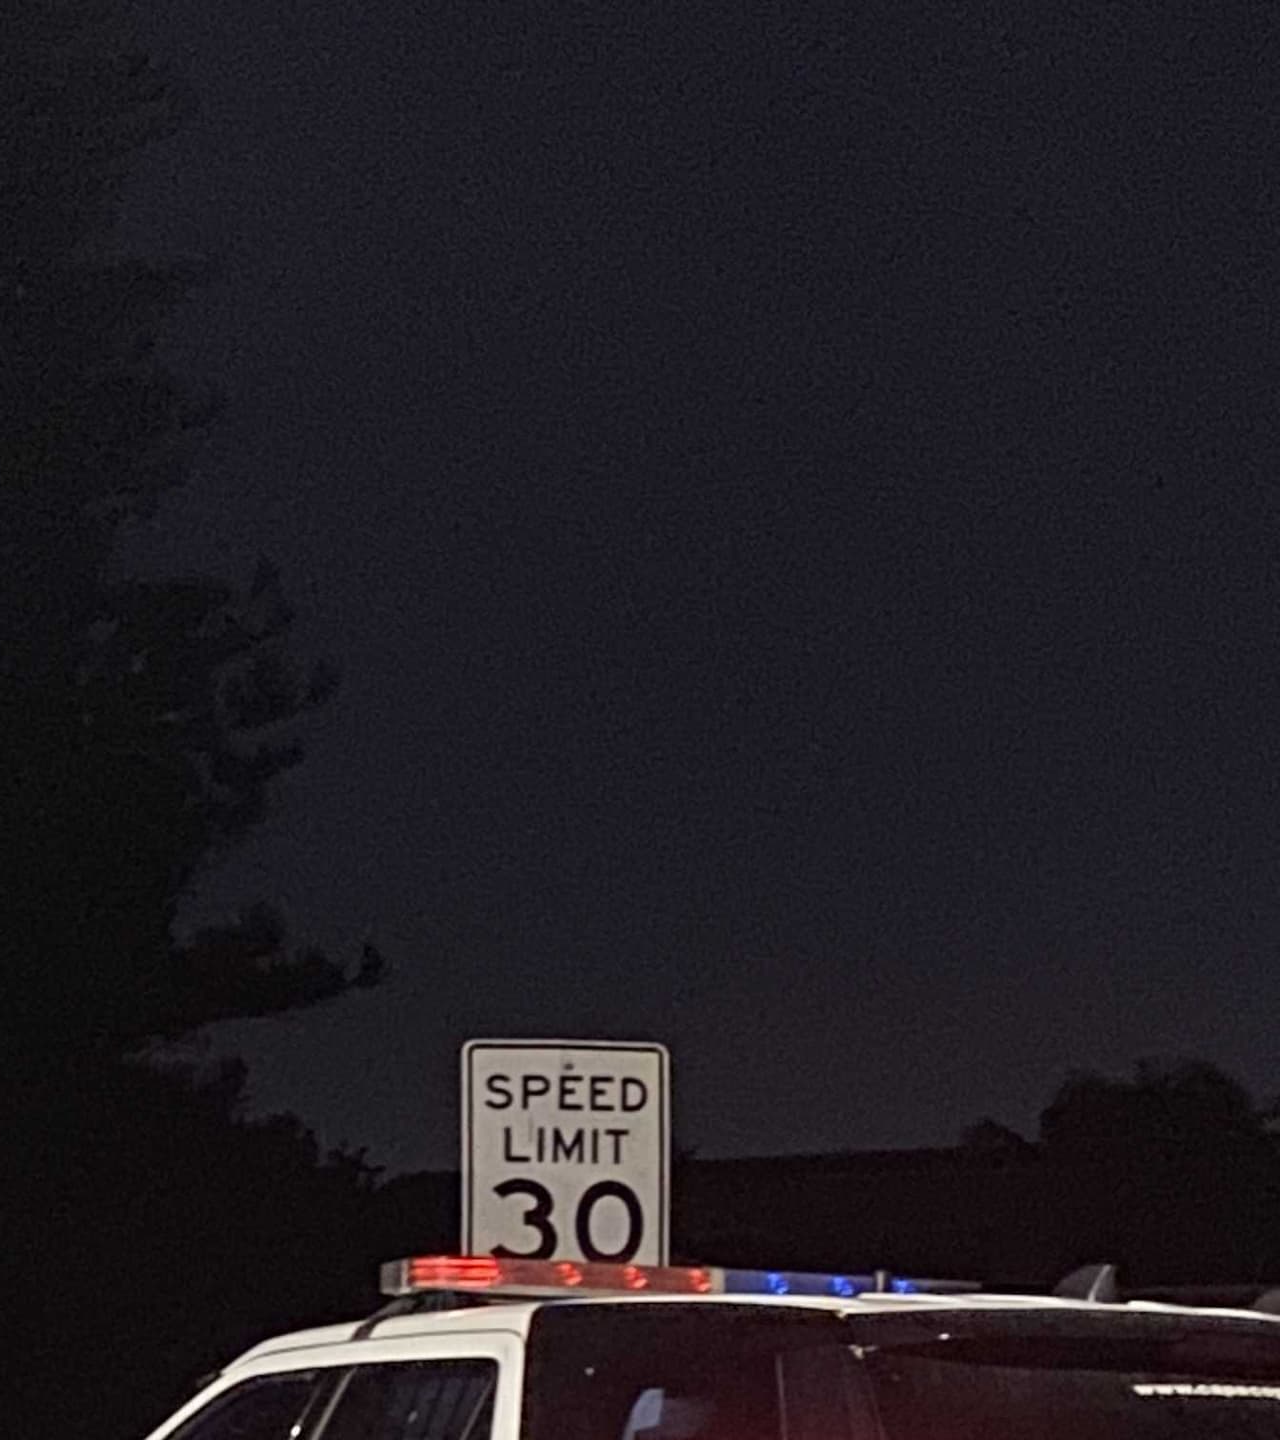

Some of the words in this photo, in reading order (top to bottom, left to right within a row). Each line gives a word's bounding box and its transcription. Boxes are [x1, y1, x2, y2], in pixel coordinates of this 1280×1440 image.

[484, 1073, 648, 1112] SPEED
[503, 1126, 630, 1164] LIMIT
[490, 1177, 645, 1265] 30
